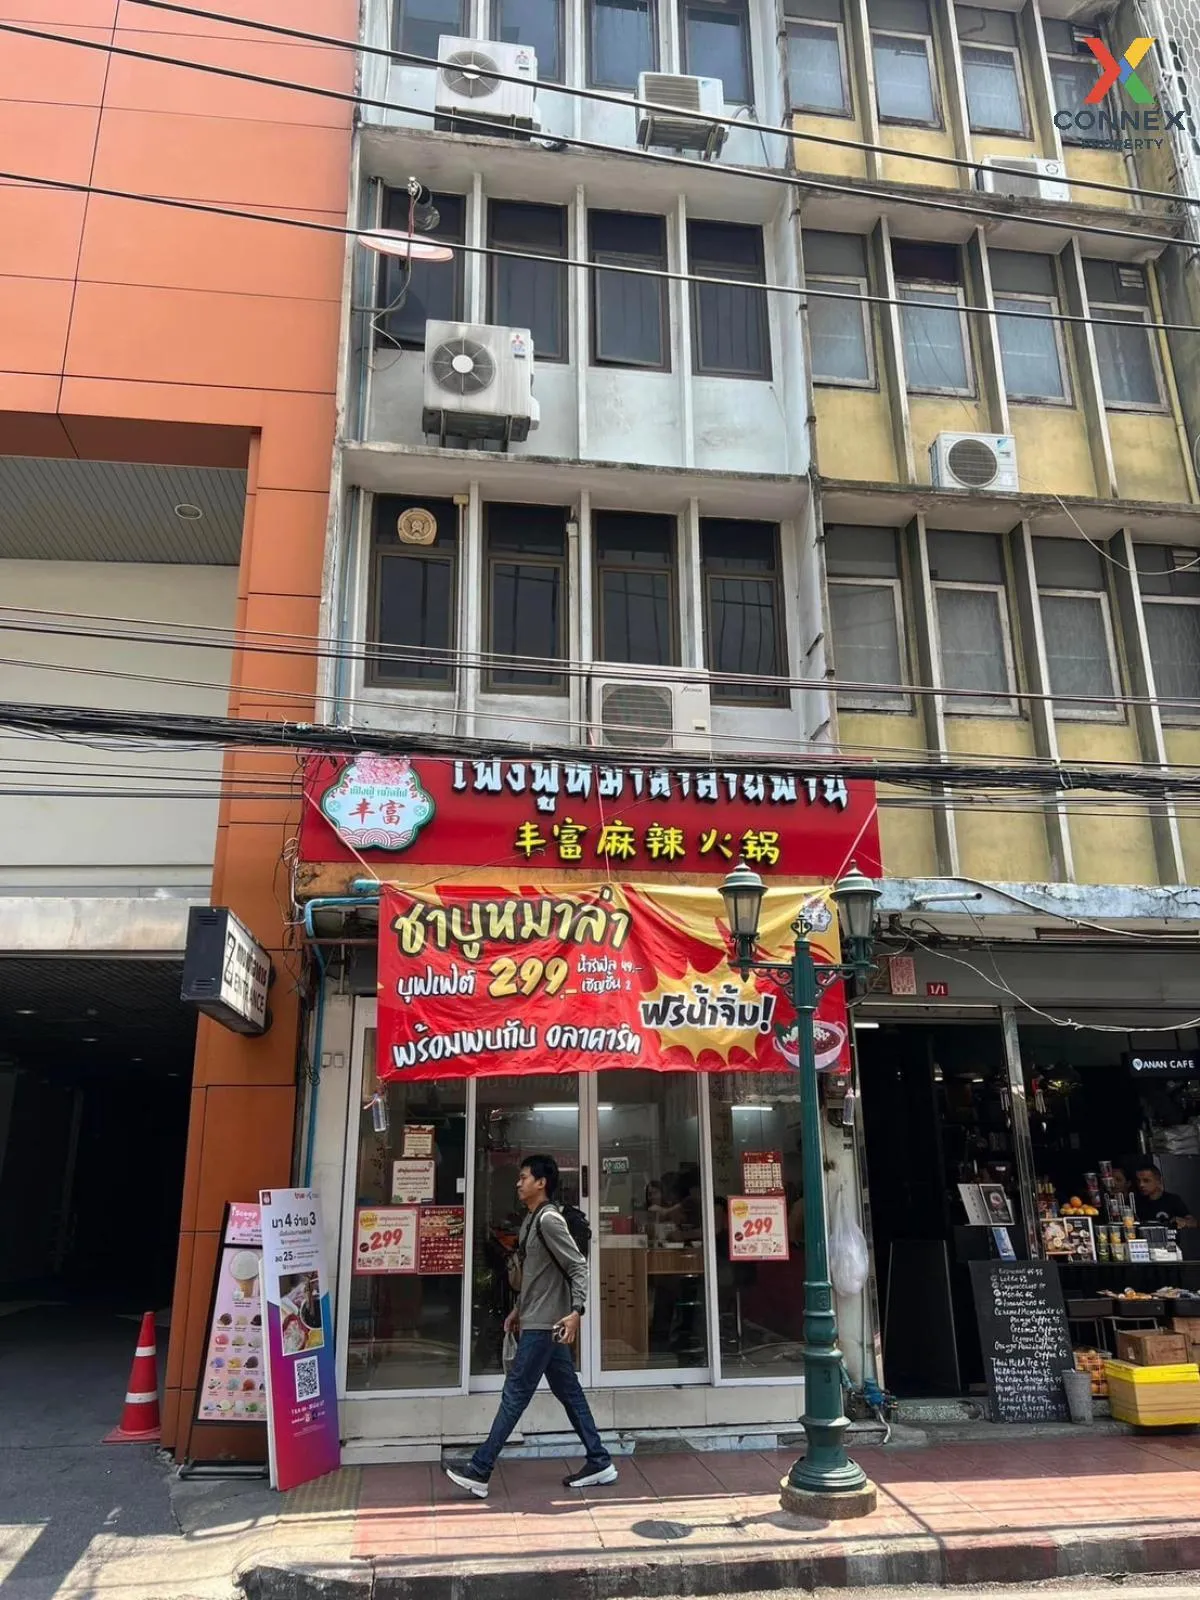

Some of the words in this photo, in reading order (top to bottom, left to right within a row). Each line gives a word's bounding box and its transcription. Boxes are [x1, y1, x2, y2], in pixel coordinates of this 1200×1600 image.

[348, 798, 406, 826] 丰富
[515, 817, 782, 865] 丰富麻辣火锅
[930, 984, 945, 995] 1/1
[640, 983, 776, 1033] ฟรีน้ำจิ้ม!
[392, 1020, 537, 1069] พร้อมพบกับ
[1143, 1060, 1168, 1069] ANAN
[1169, 1060, 1195, 1069] CAFE
[284, 1213, 292, 1227] 4
[309, 1211, 317, 1226] 3
[743, 1217, 773, 1238] 299
[370, 1228, 403, 1251] 299
